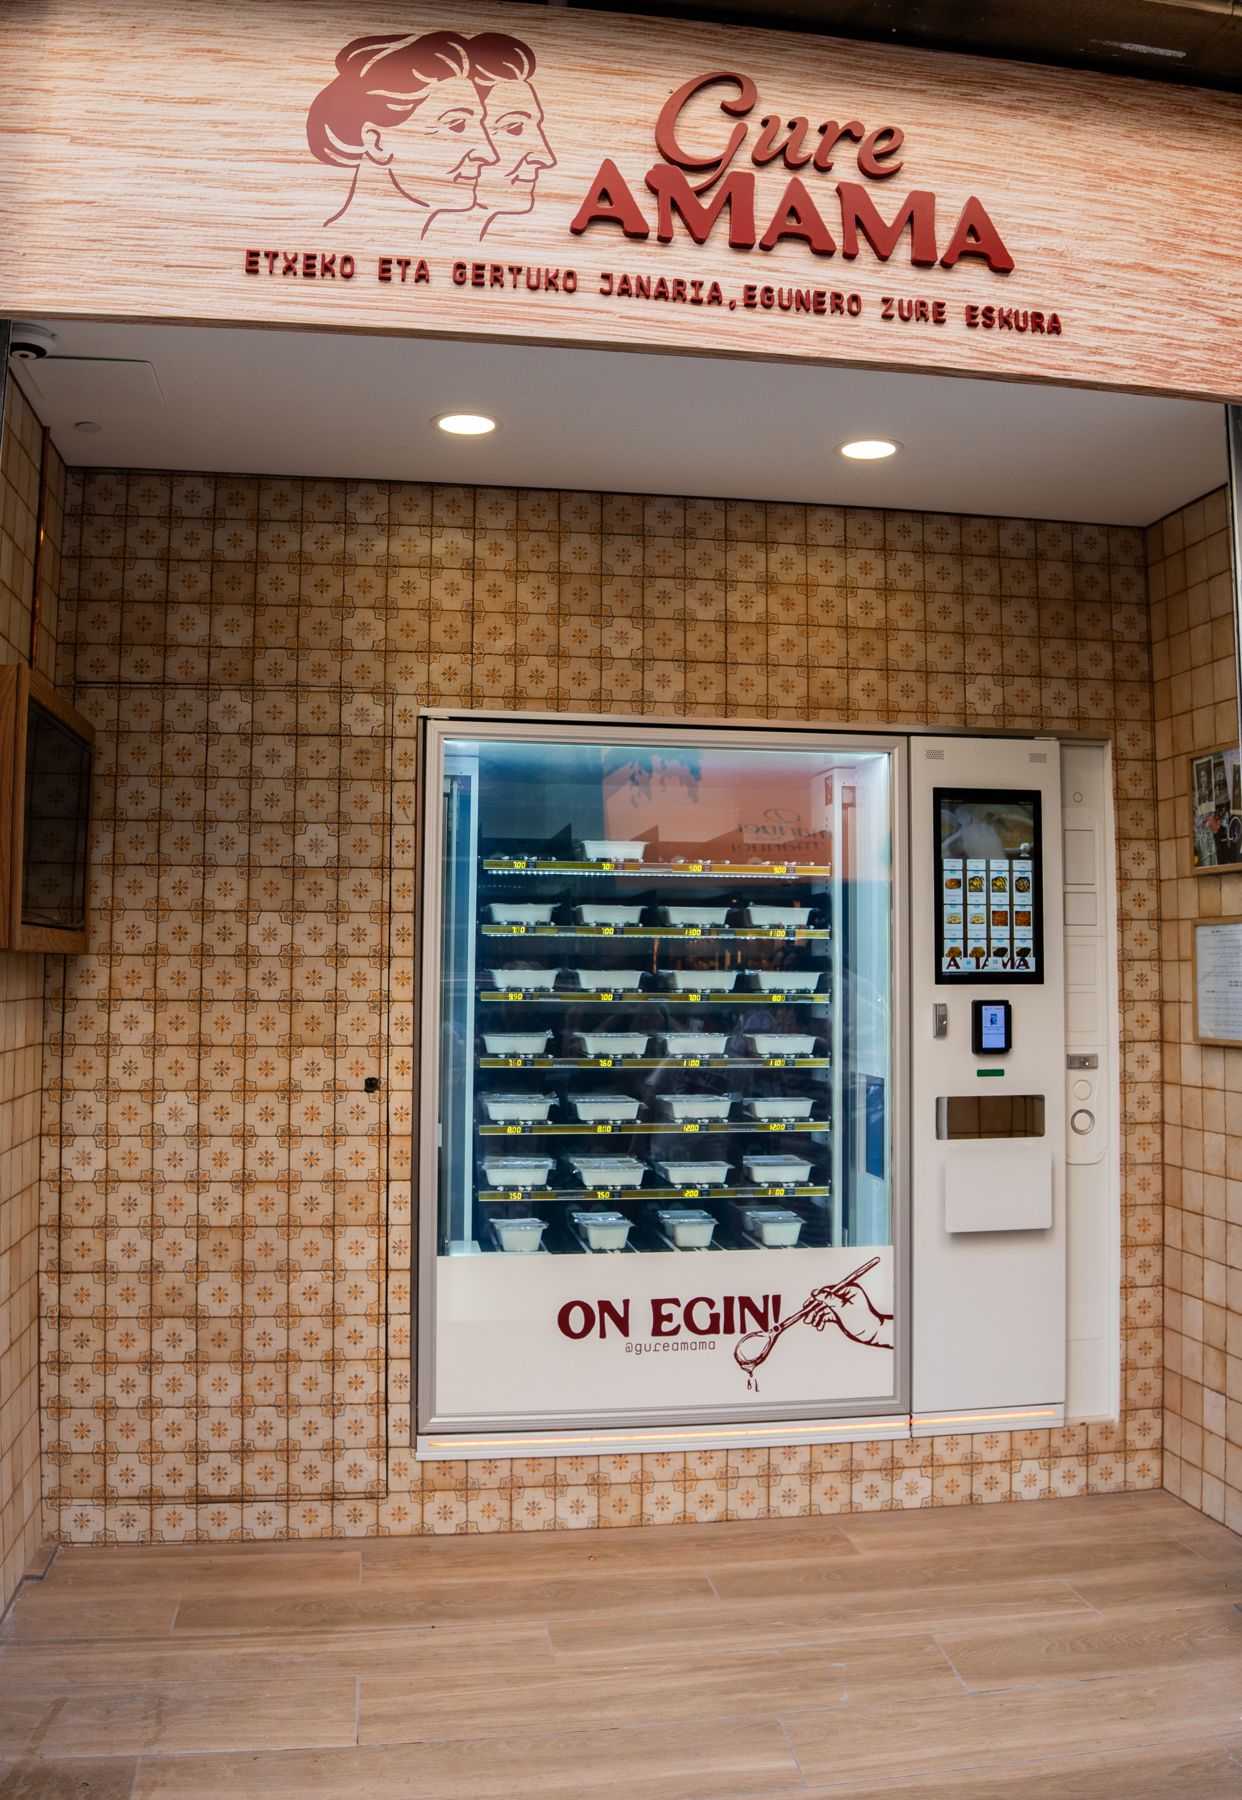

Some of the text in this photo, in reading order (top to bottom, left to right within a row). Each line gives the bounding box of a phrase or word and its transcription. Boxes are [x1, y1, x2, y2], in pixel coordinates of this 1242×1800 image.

[655, 71, 905, 196] Gure
[570, 158, 1016, 274] AMAMA
[245, 249, 355, 278] ETXEKO
[378, 257, 430, 283] ETA
[452, 261, 577, 294] GERTUKO
[881, 296, 947, 324] ZURE
[964, 304, 1062, 335] ESKURA
[557, 1294, 782, 1339] ON EGIN!
[625, 1340, 716, 1355] @gureamama
